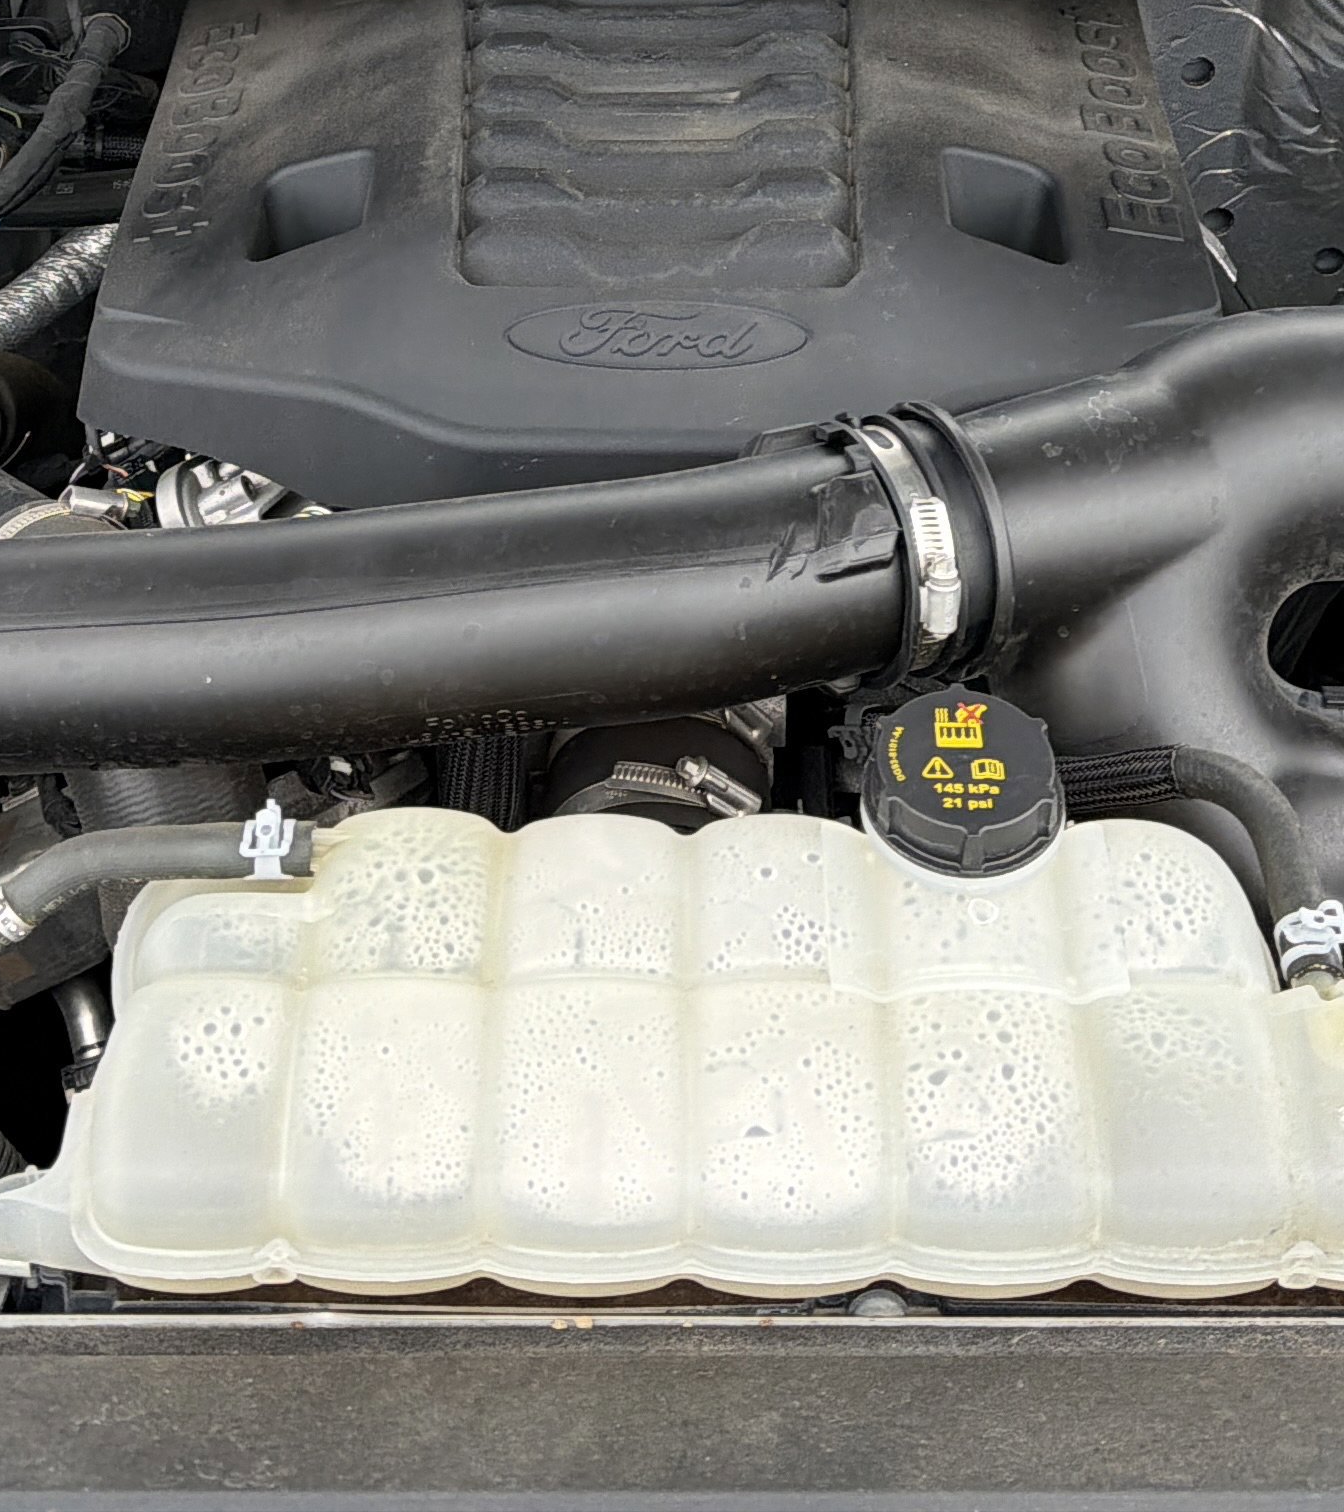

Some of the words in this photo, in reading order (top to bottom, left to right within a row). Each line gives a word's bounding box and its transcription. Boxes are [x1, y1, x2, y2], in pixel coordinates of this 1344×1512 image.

[559, 309, 758, 359] Ford
[932, 783, 964, 794] 145
[968, 783, 1001, 795] kPa
[942, 798, 963, 809] 21
[967, 797, 994, 810] psi
